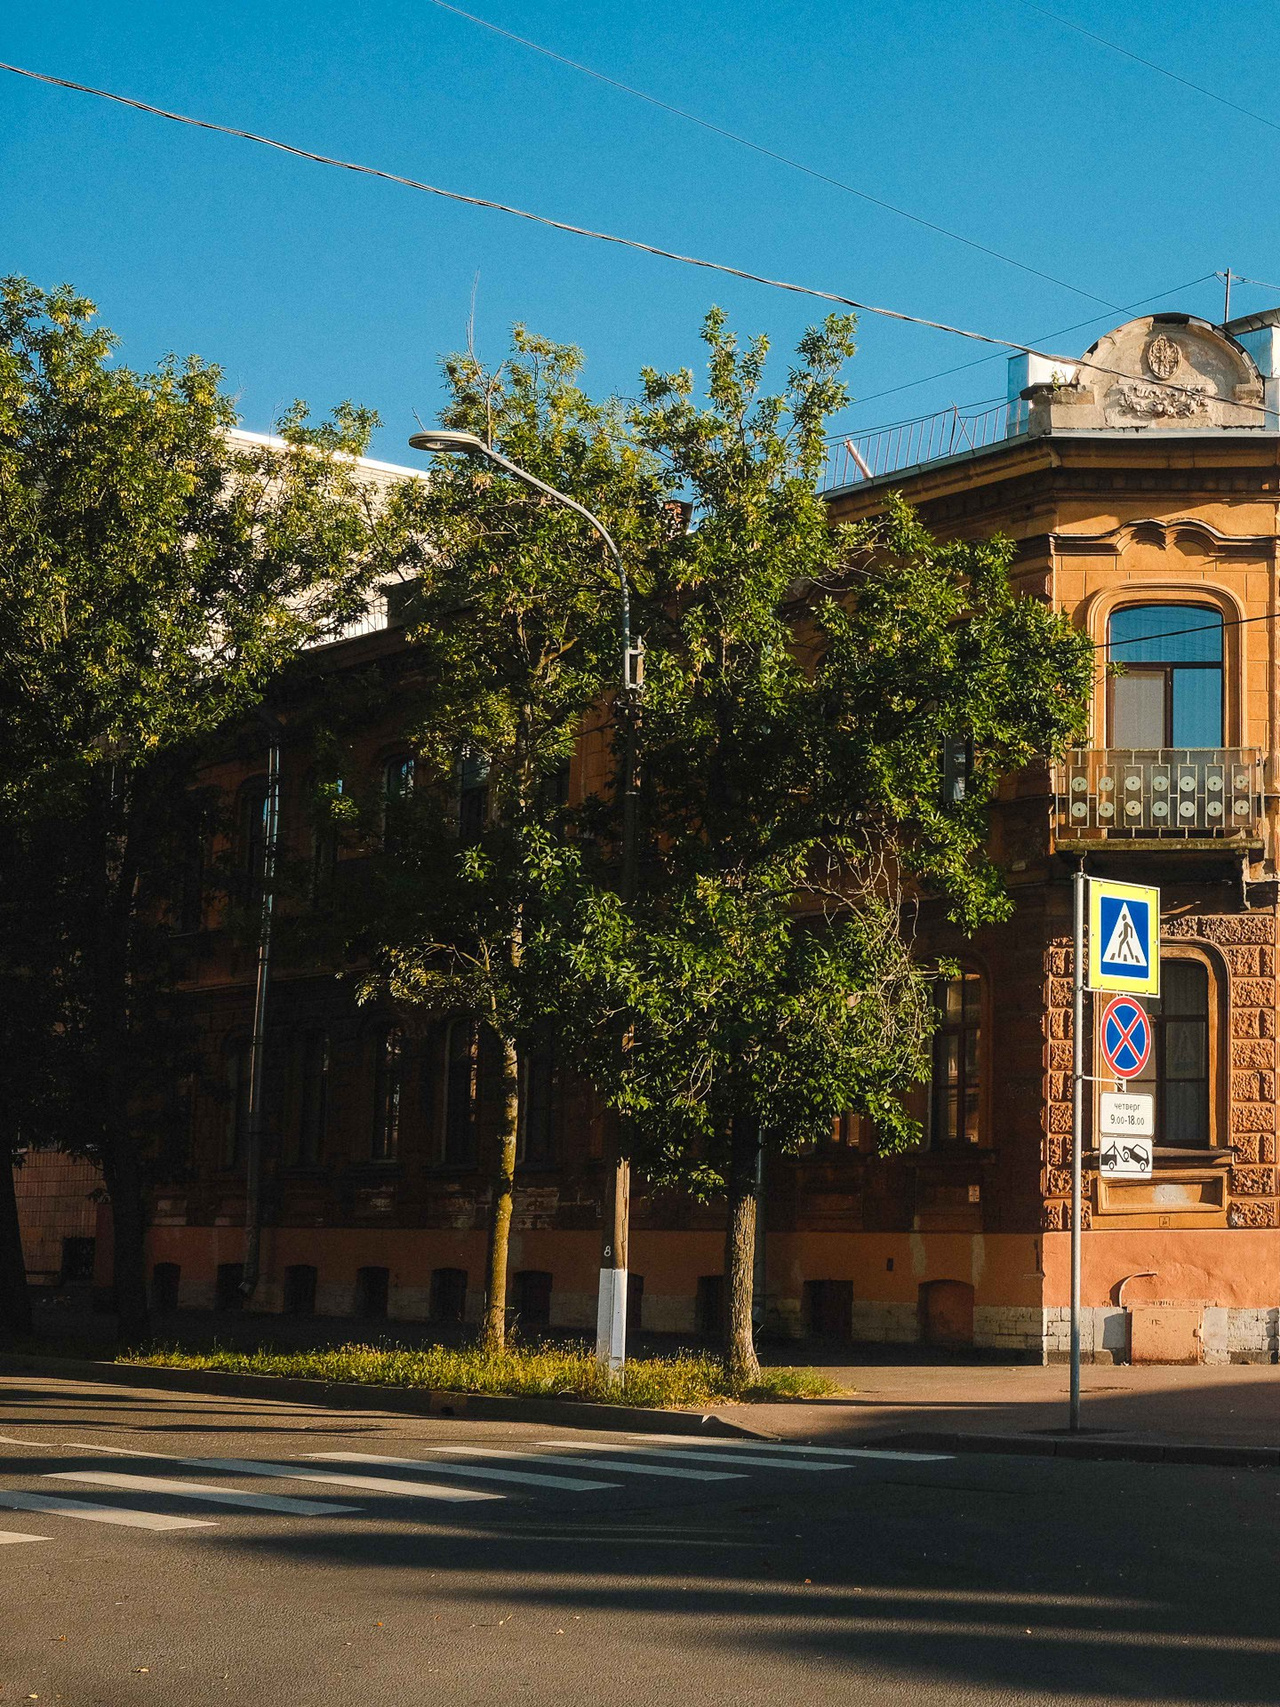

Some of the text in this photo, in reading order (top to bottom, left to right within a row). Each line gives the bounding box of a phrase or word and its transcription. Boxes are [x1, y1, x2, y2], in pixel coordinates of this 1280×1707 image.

[1114, 1102, 1140, 1112] четверг
[1110, 1114, 1145, 1126] 9.00-18.00
[603, 1245, 612, 1257] 8
